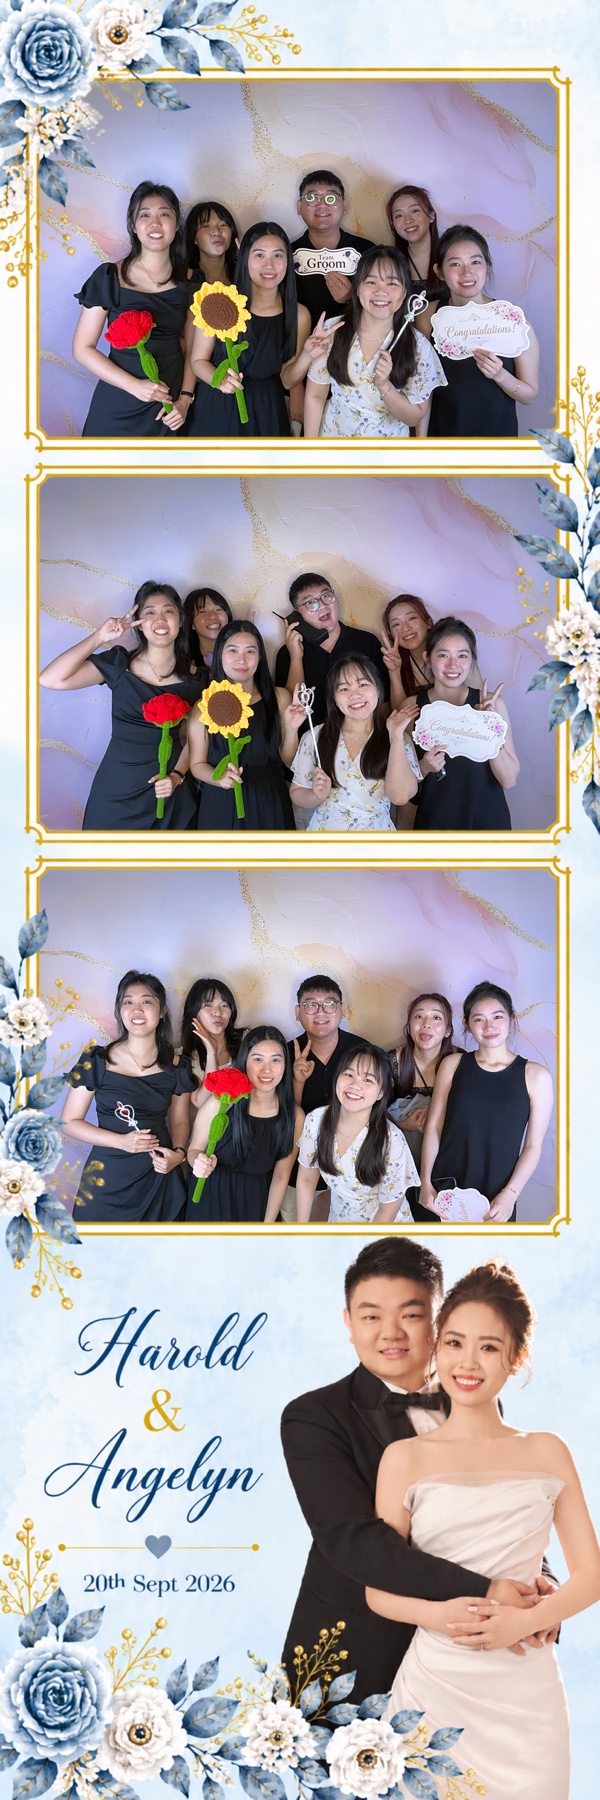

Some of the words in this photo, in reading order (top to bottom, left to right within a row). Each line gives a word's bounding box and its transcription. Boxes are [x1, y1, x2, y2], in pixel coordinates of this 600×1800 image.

[306, 258, 346, 269] Groom
[444, 323, 516, 341] Congratulations!
[430, 719, 497, 742] Congratulations!
